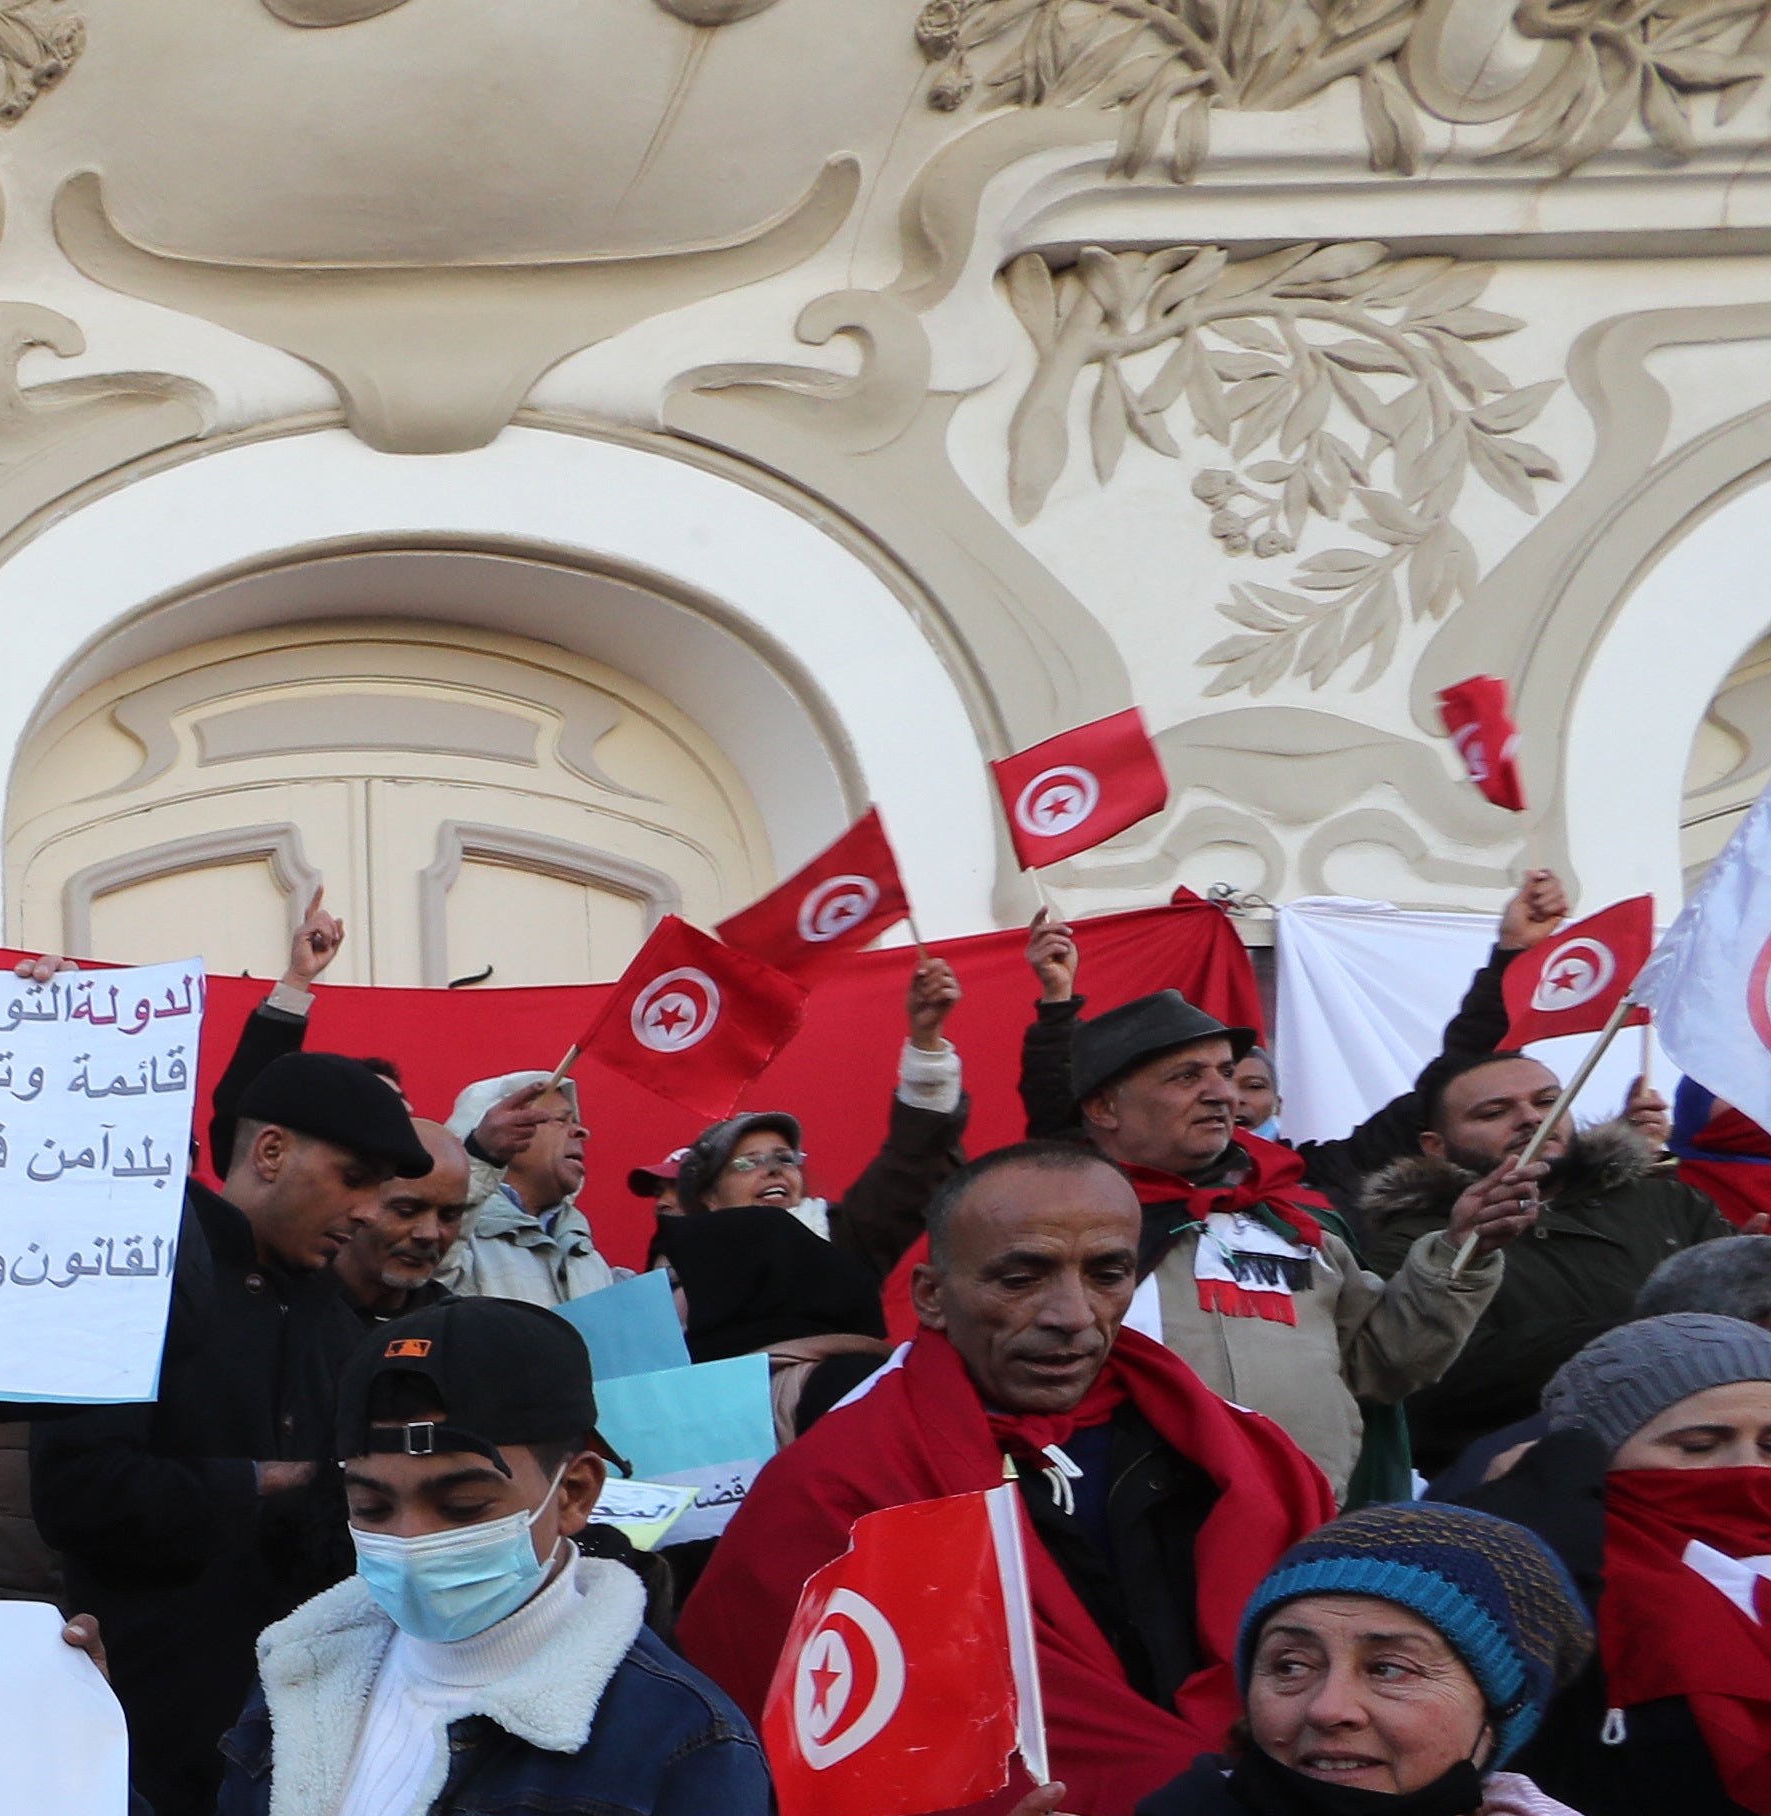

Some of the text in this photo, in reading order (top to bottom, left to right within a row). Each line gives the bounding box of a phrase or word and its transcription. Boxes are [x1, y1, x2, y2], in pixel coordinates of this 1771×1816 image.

[74, 972, 205, 1034] الدولة
[67, 1045, 189, 1099] قائمة
[11, 1235, 176, 1288] القانون
